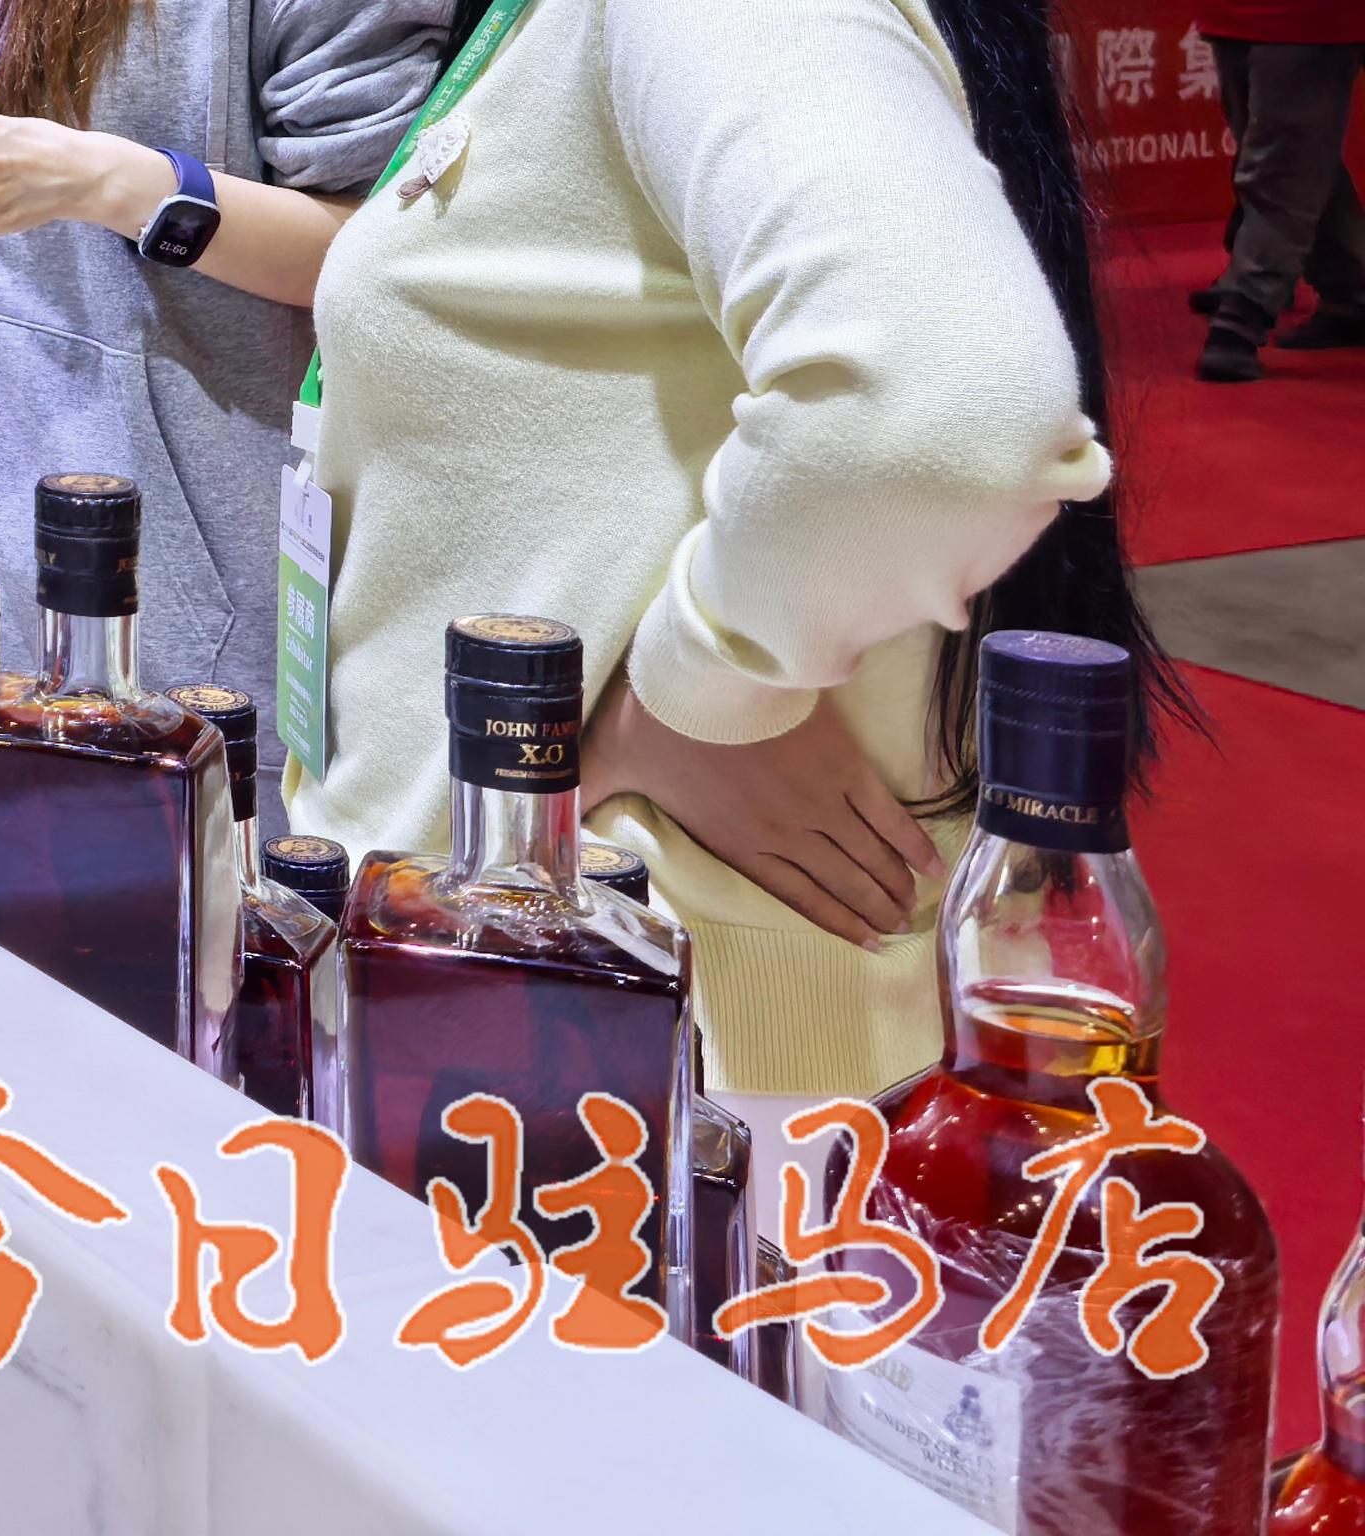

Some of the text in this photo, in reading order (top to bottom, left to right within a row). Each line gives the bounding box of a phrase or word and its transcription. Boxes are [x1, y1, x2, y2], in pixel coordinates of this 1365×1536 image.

[1095, 130, 1213, 165] ATIONAL
[485, 718, 537, 738] JOHN
[1007, 795, 1100, 824] MIRACLE
